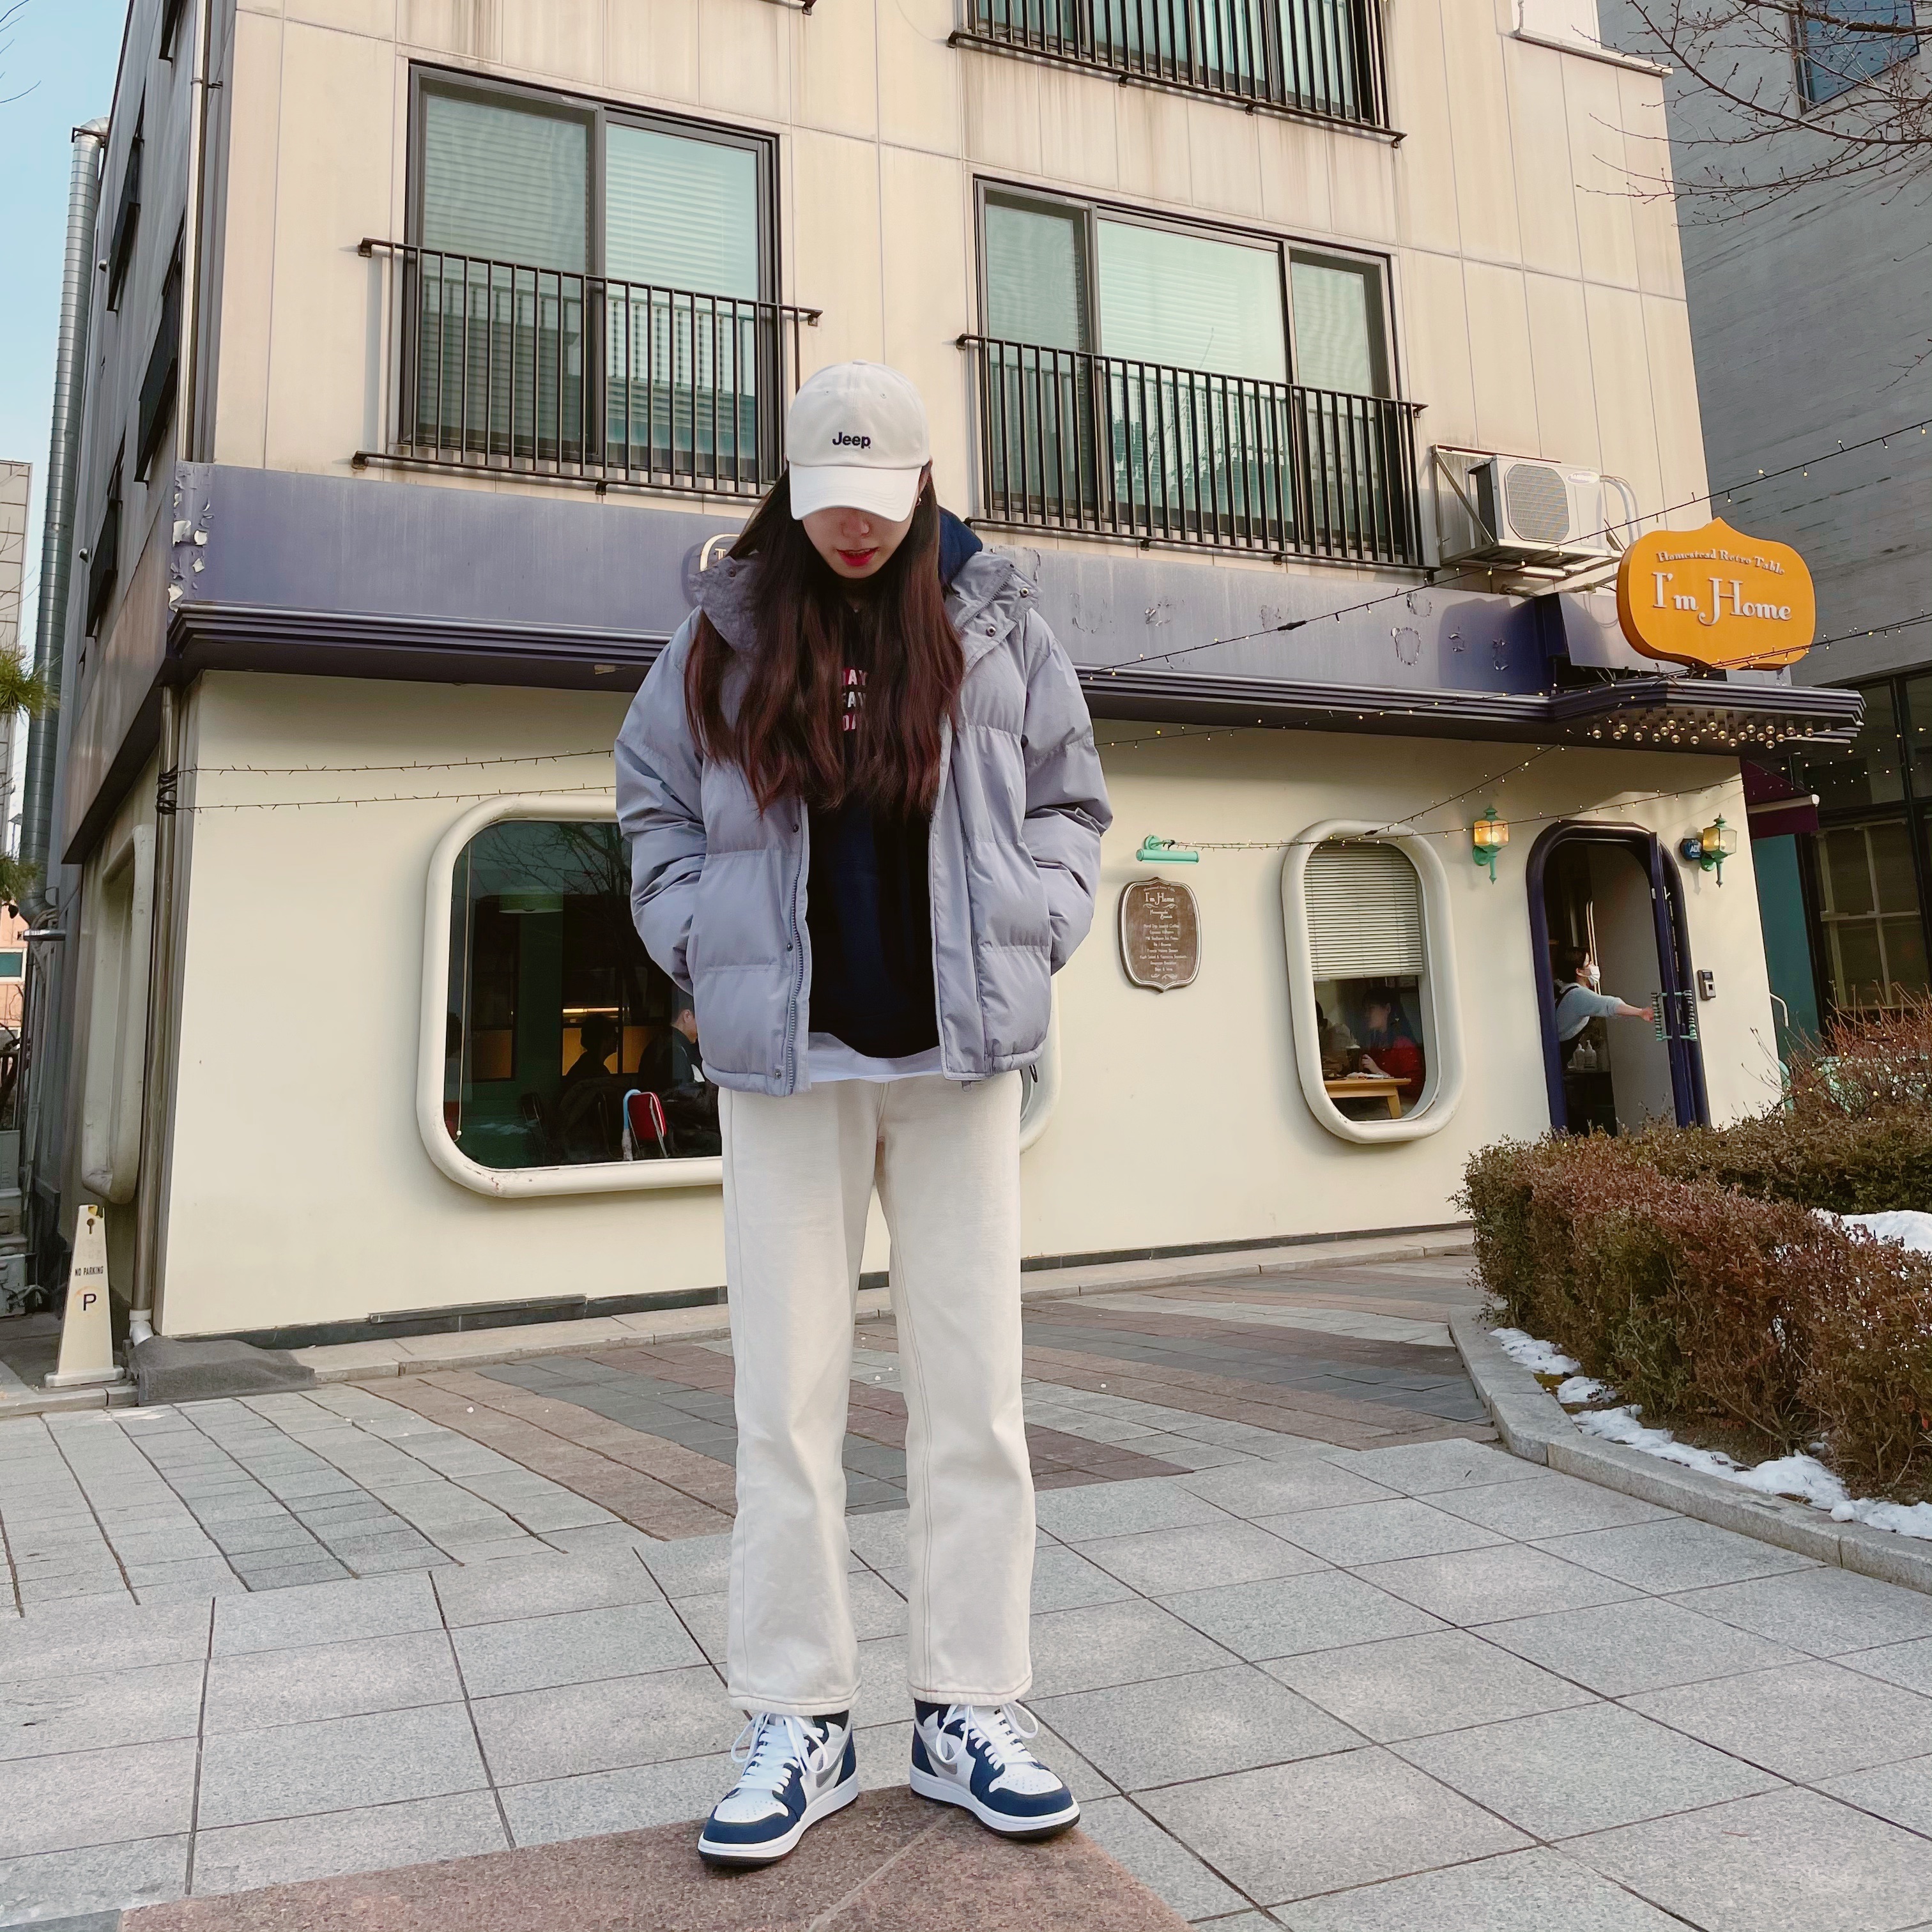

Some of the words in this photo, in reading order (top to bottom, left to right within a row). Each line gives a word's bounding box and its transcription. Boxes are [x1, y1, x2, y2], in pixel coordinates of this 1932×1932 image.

[832, 431, 871, 449] Jeep
[1657, 549, 1717, 563] Homestead
[1719, 549, 1752, 565] Retro
[1754, 556, 1785, 575] Table
[1652, 571, 1699, 611] I'm
[1698, 577, 1792, 626] Home
[75, 1268, 82, 1276] NO
[83, 1266, 104, 1276] PARKING
[83, 1293, 96, 1311] P
